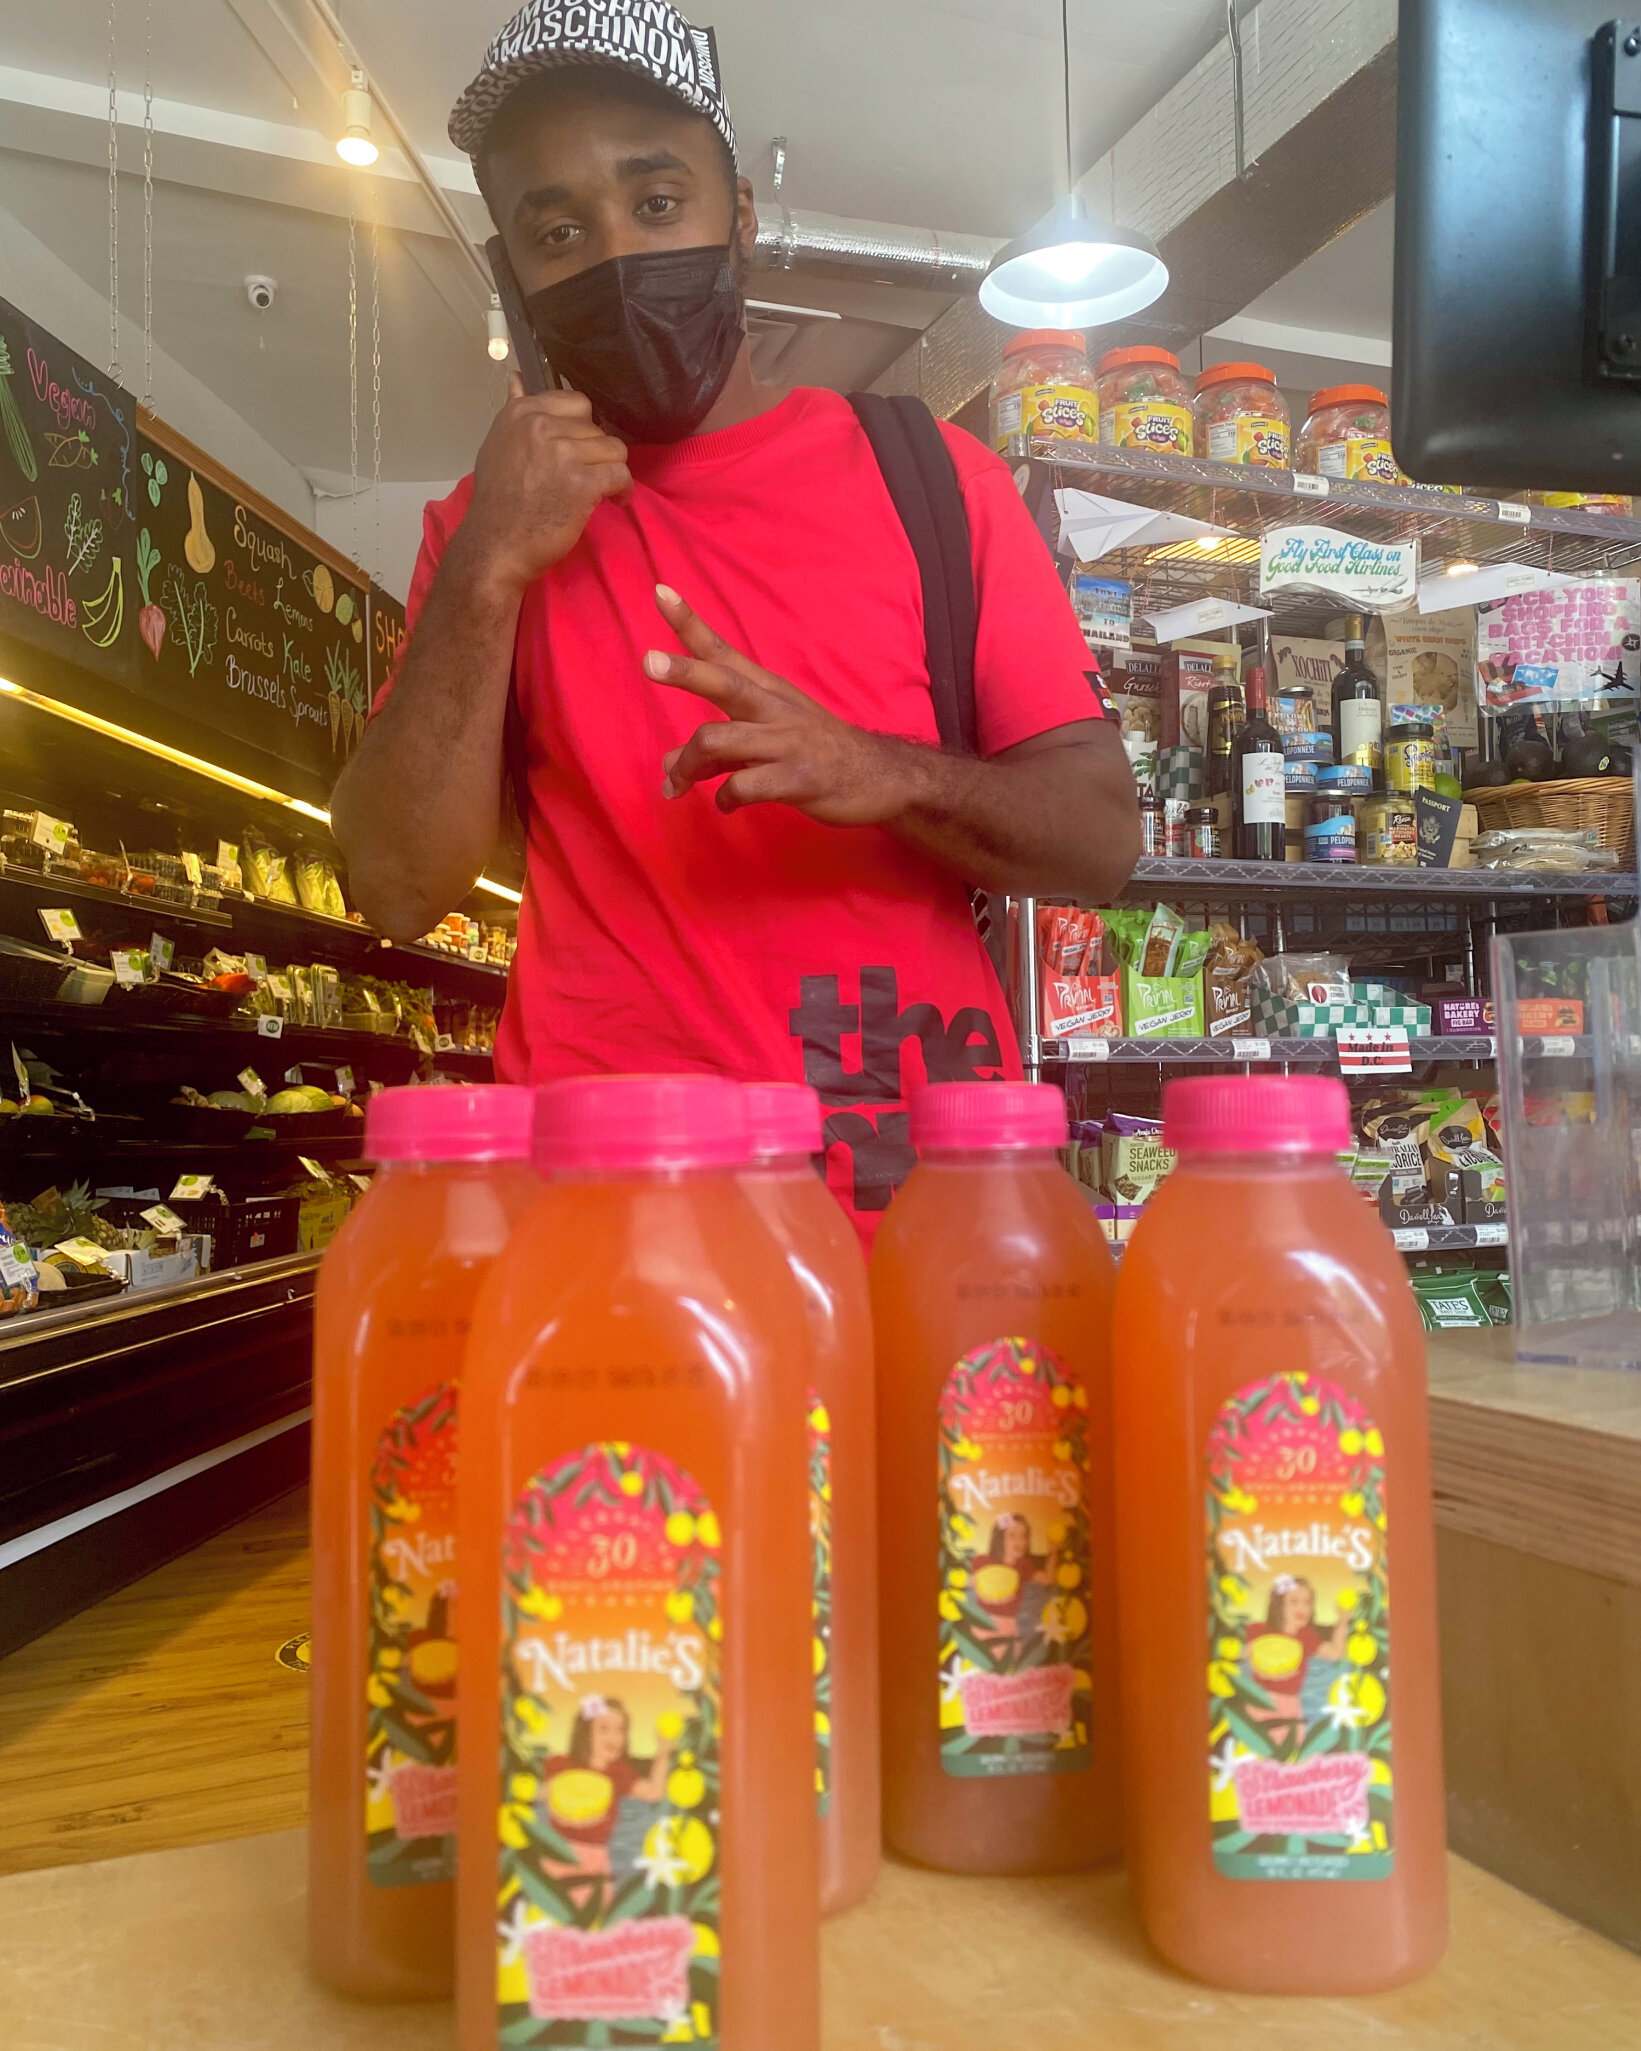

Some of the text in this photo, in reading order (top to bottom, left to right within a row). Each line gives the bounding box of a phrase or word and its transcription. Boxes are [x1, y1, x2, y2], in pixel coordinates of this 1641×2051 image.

[27, 347, 96, 430] Vegan
[1054, 399, 1079, 408] FRUIT
[1147, 415, 1172, 425] FRUIT
[233, 505, 297, 580] Squash
[1280, 538, 1401, 563] Fly First Class on
[1265, 554, 1400, 582] Good Food Airlines
[224, 559, 265, 606] Beets
[1563, 586, 1627, 601] YOUR
[273, 577, 313, 632] Lemons
[1502, 602, 1617, 623] SHOPPING
[226, 606, 273, 658] Carrots
[1104, 617, 1116, 626] TO
[1488, 616, 1630, 638] BAGS FOR A
[1082, 628, 1130, 643] HAILAND
[1508, 631, 1611, 651] KITCHEN
[283, 632, 312, 684] Kale
[1388, 647, 1417, 656] ORGANIC
[1488, 645, 1623, 667] VACATION!
[226, 654, 328, 728] Brussels Sprouts
[1337, 777, 1369, 787] PELOPONNESE
[1422, 796, 1451, 812] PASSPORT
[1392, 815, 1411, 825] Reese
[1055, 1007, 1112, 1031] VEGAN JERKY
[1138, 1008, 1193, 1031] VEGAN JERKY
[1212, 1010, 1250, 1033] VEGAN JERKY
[1444, 1010, 1480, 1019] BAKERY
[267, 1021, 279, 1030] NEW
[788, 965, 1006, 1107] the
[1348, 1041, 1394, 1053] Made in
[1361, 1055, 1384, 1066] D.C.
[1129, 1147, 1176, 1160] SEAWEED
[1129, 1159, 1170, 1172] SNACKS
[1400, 1208, 1430, 1224] Darrell
[1430, 1300, 1469, 1311] TATE'S
[998, 1400, 1034, 1431] 30
[1276, 1445, 1317, 1480] 30
[586, 1531, 638, 1578] 30
